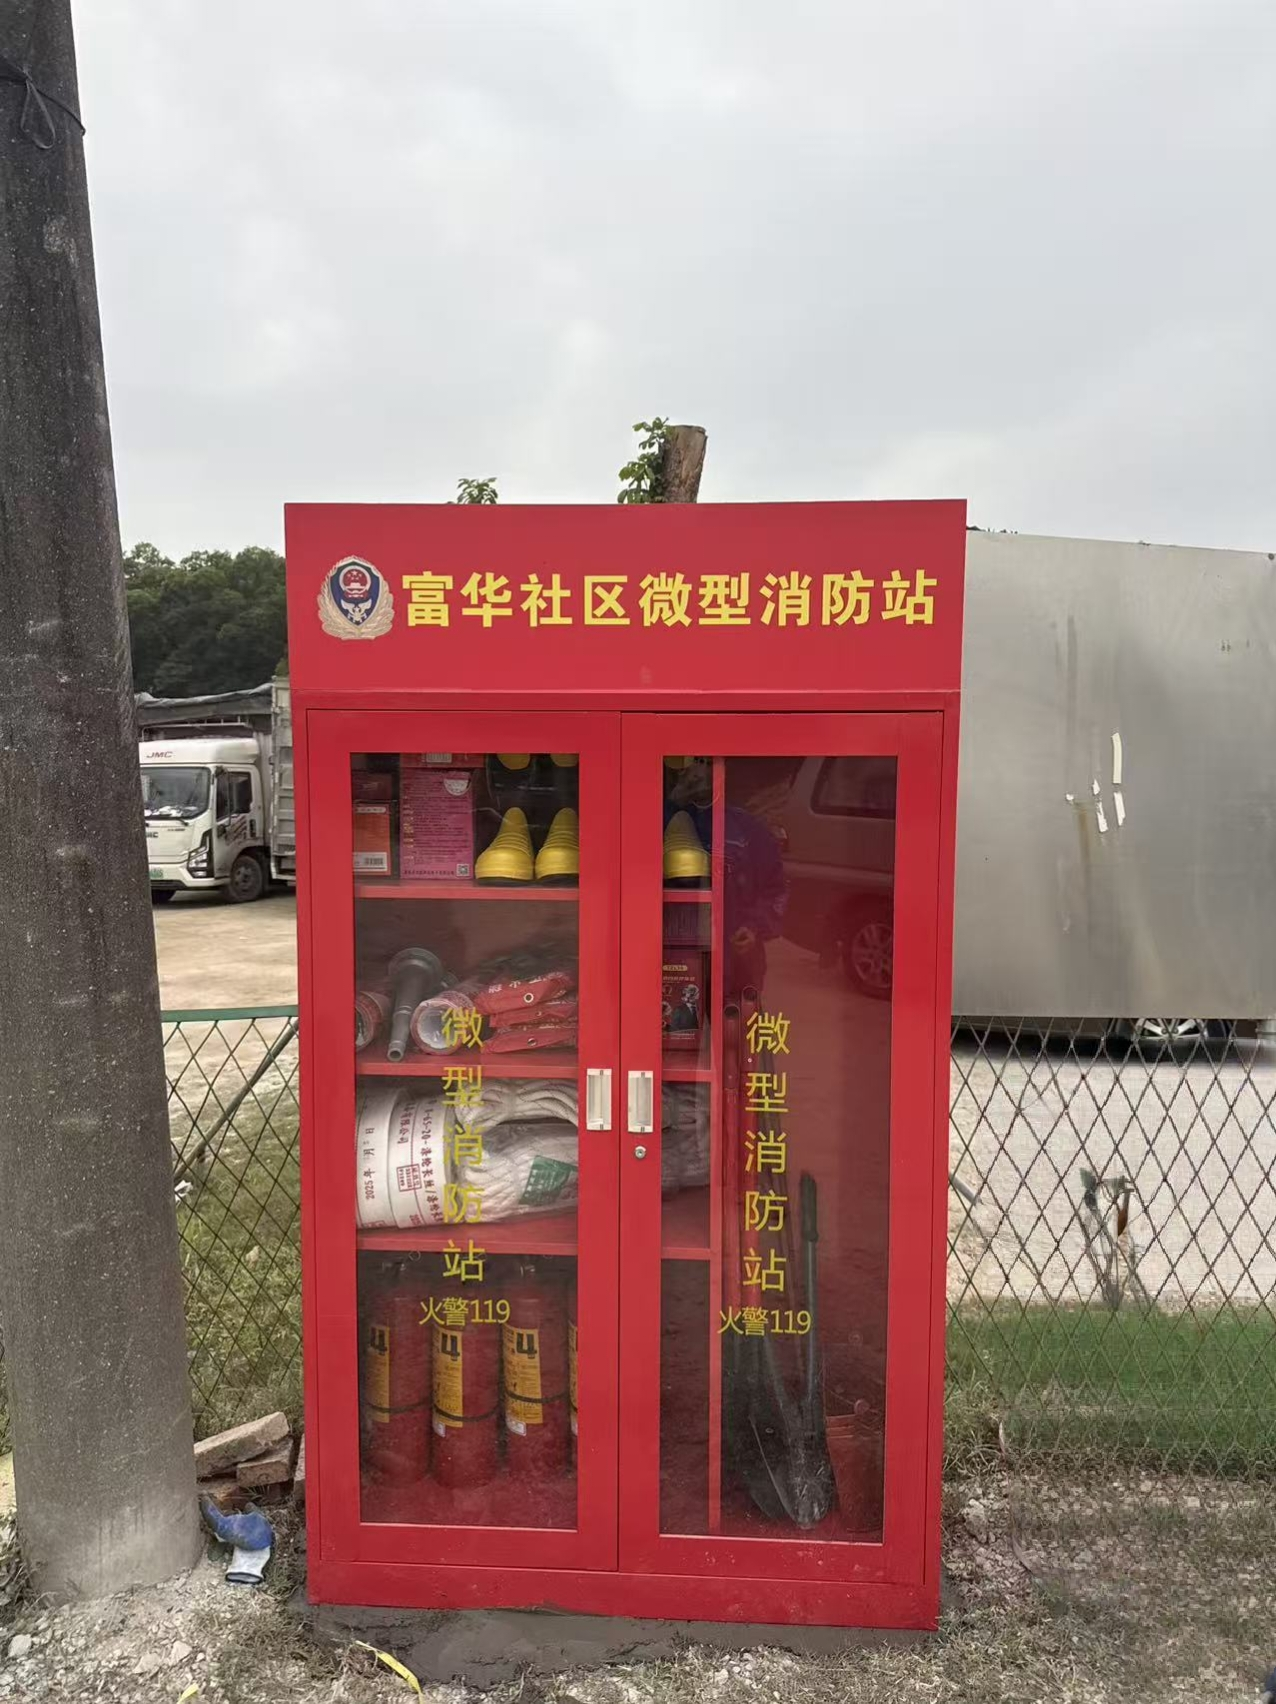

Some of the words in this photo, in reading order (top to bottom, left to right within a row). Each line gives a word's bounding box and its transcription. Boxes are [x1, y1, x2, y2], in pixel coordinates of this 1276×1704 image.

[402, 570, 937, 627] 富华社区微型消防站
[146, 751, 173, 759] JMC
[442, 1006, 485, 1282] 微型消防站
[743, 1011, 790, 1292] 微型消防站
[418, 1297, 511, 1326] 火警119
[717, 1306, 811, 1336] 火警119
